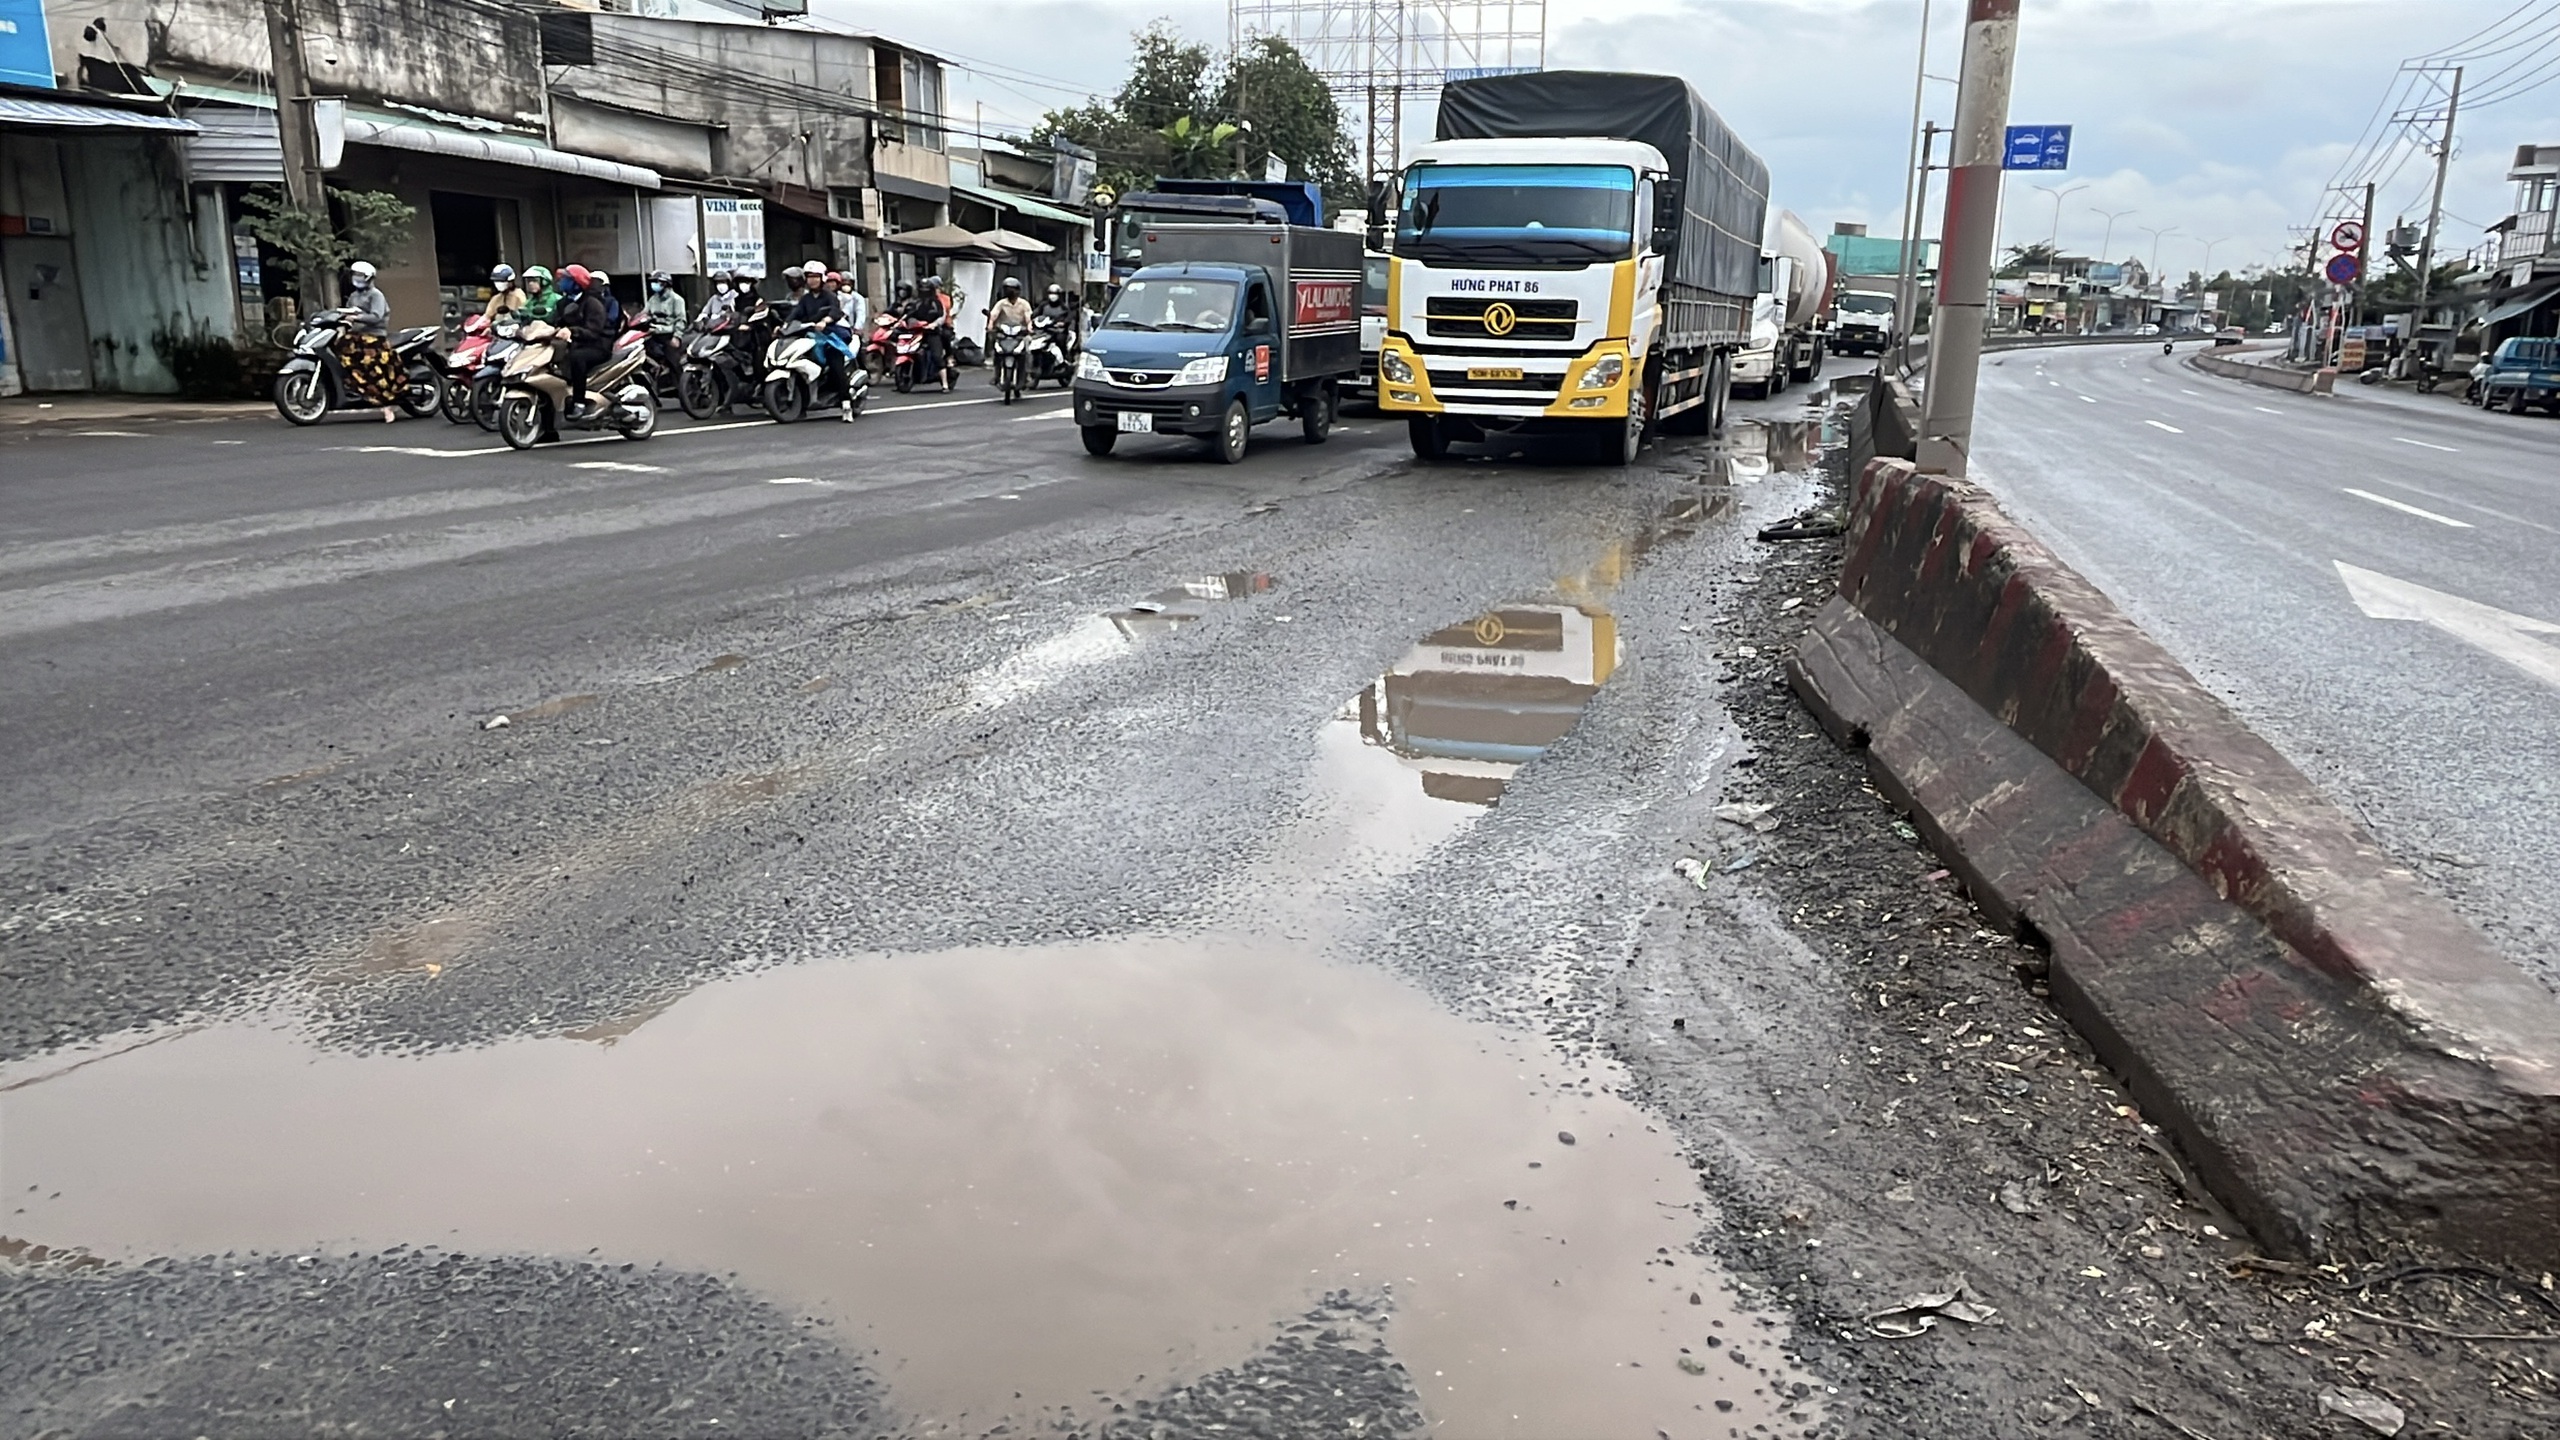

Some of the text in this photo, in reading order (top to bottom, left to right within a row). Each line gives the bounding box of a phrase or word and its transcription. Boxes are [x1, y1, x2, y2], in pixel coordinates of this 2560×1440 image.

[705, 200, 737, 212] VINH
[1524, 281, 1539, 293] 86
[1306, 286, 1352, 308] LALAMOVE
